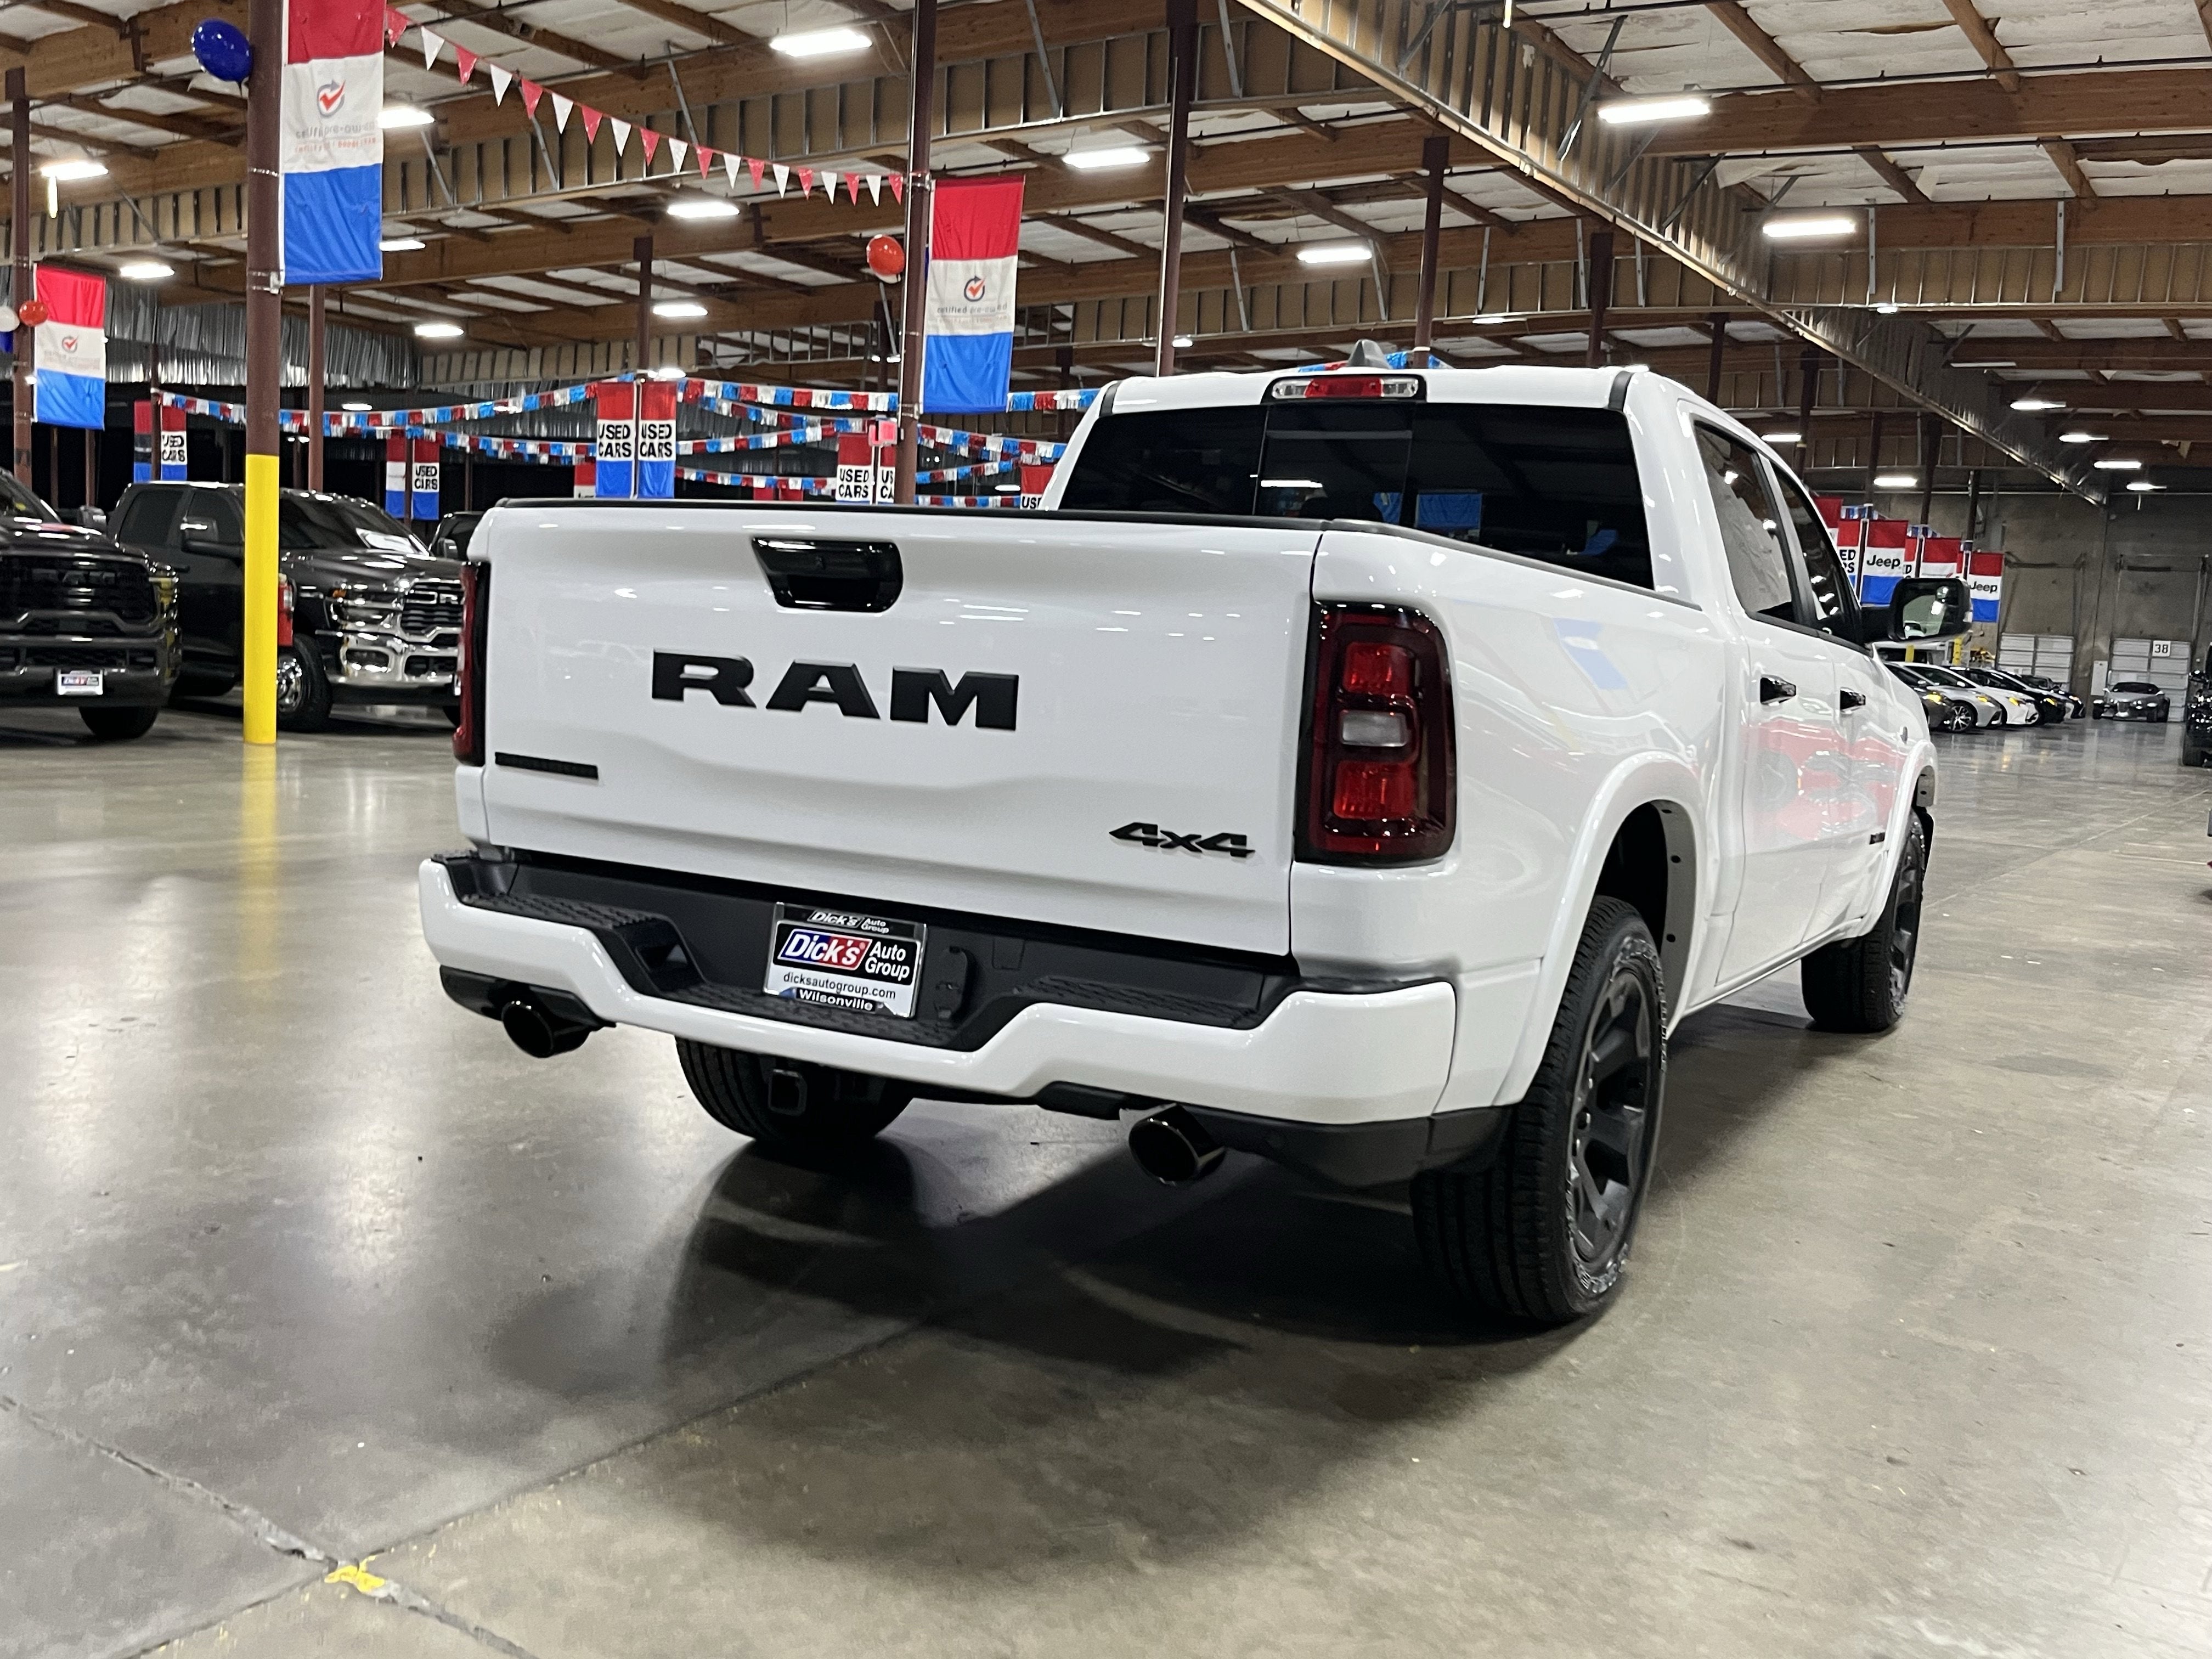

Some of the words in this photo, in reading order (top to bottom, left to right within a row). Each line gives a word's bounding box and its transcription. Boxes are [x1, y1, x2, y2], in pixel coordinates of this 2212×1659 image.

[969, 302, 1007, 314] pre-owed
[599, 424, 631, 439] USED
[641, 424, 673, 439] USED
[599, 442, 631, 458] CARS
[640, 442, 673, 458] CARS
[415, 465, 437, 477] USED
[839, 468, 869, 482] USED
[882, 470, 894, 484] US
[839, 484, 868, 498] CARS
[881, 486, 894, 499] CA
[1022, 496, 1042, 509] US
[1839, 549, 1856, 561] ED
[1866, 555, 1901, 569] Jeep
[1970, 581, 1997, 593] Jeep
[2154, 644, 2169, 653] 38
[652, 648, 1019, 731] RAM
[1109, 822, 1256, 858] 4x4
[811, 911, 858, 927] Dick's
[865, 918, 887, 927] Auto
[861, 922, 889, 934] Group
[785, 934, 861, 966] Dick's
[869, 941, 906, 961] Auto
[865, 957, 910, 981] Group
[783, 972, 896, 999] dicksautogroup.com
[799, 989, 873, 1011] Wilsonville
